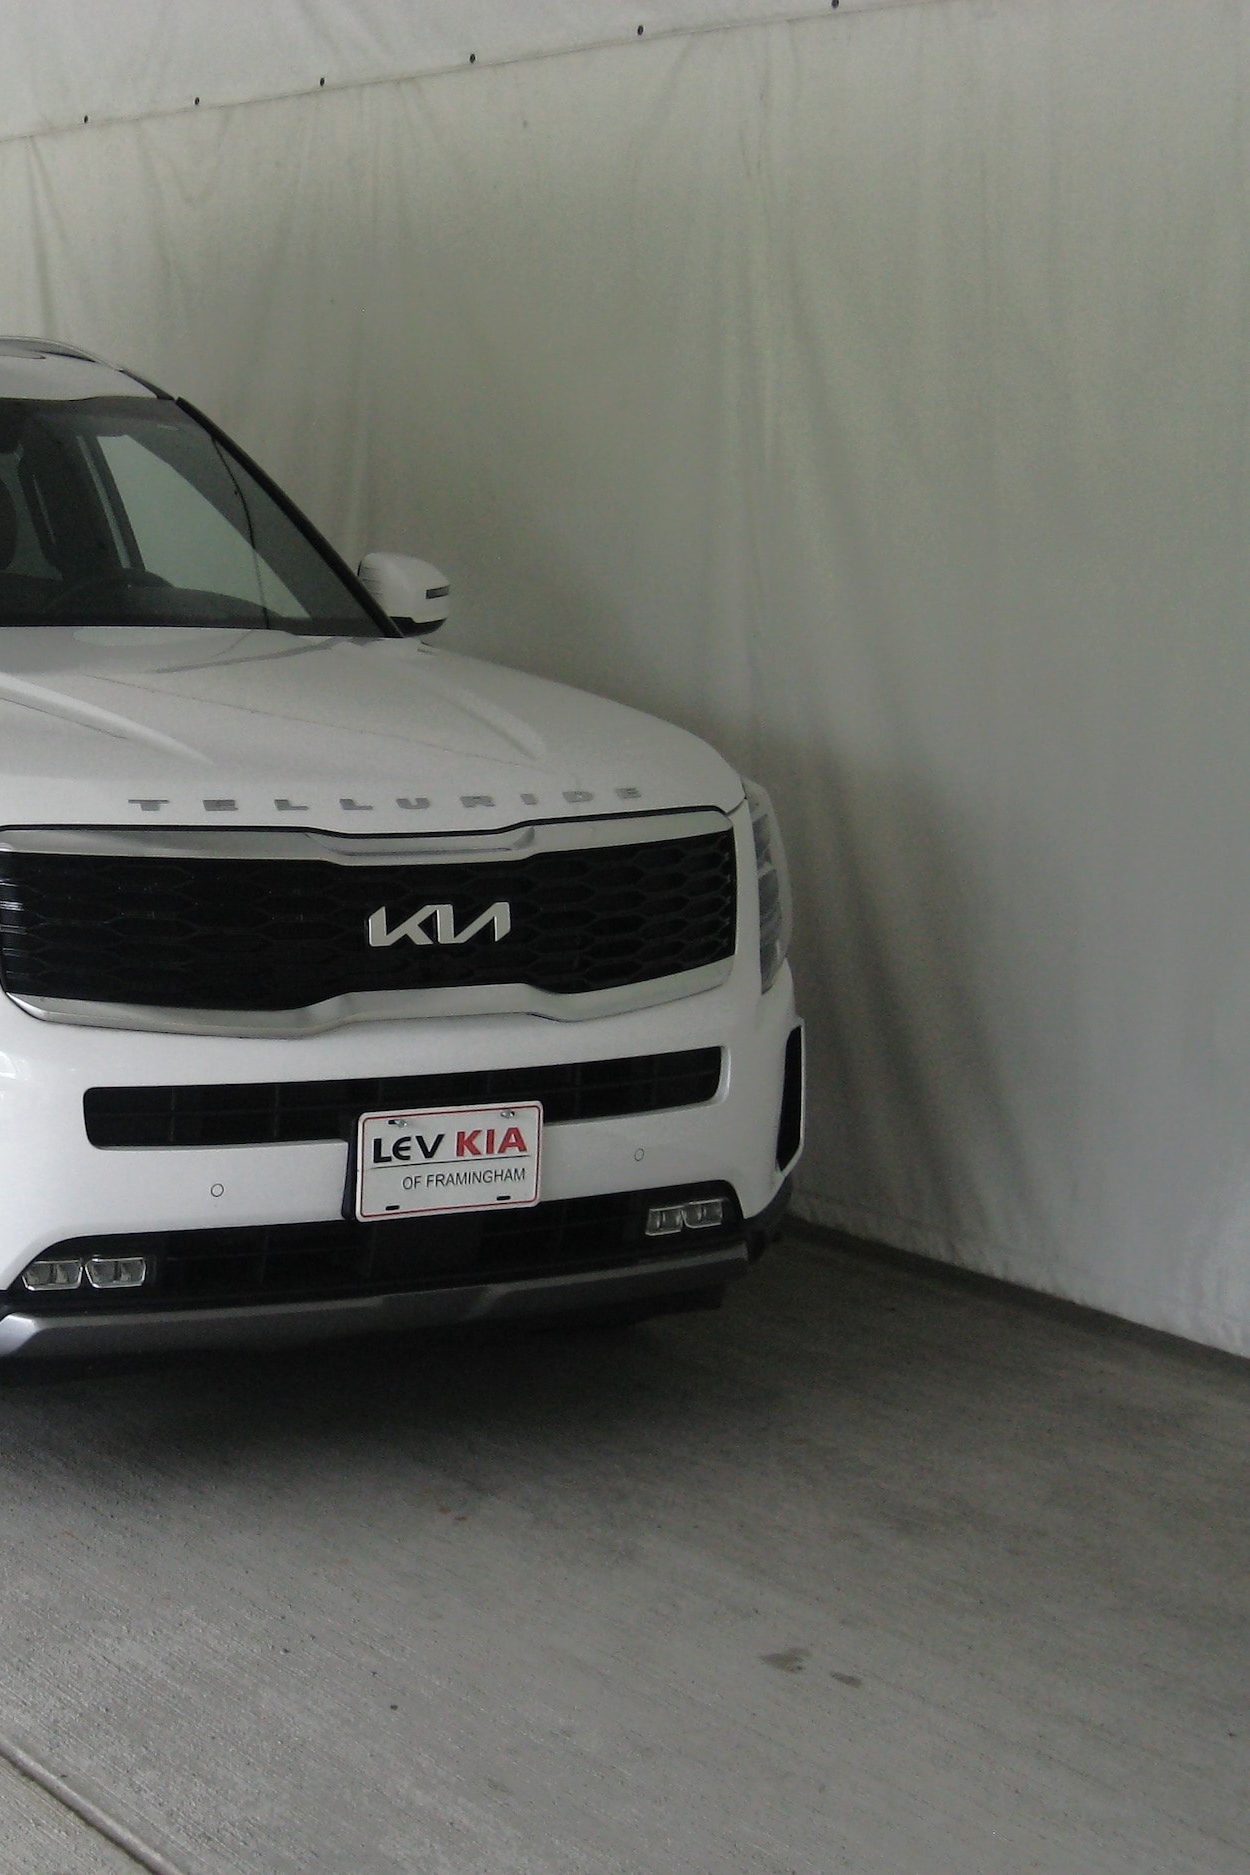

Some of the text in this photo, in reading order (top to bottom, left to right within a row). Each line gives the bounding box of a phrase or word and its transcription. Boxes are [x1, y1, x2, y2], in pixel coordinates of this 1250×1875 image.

[128, 787, 642, 812] TELLURIDE
[368, 902, 511, 947] KIA
[373, 1127, 528, 1164] LEV KIA
[402, 1167, 525, 1190] OF FRAMINGHAM
